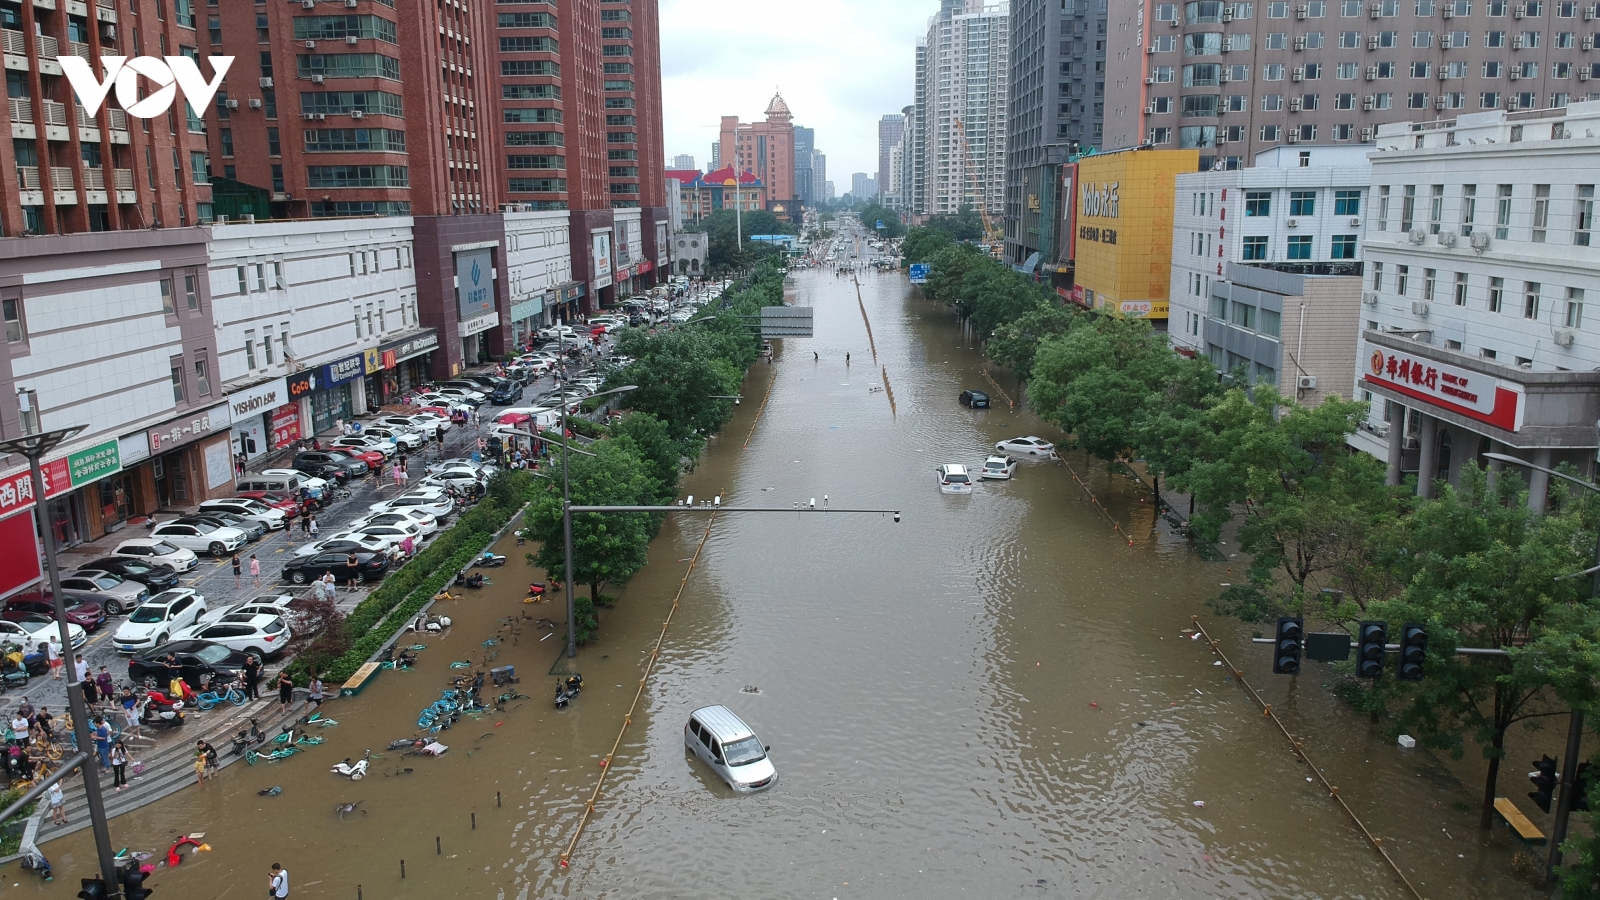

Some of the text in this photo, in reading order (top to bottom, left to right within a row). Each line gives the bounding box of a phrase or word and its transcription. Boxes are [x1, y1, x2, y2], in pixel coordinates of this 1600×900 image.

[1063, 177, 1072, 220] 7
[1082, 182, 1100, 217] Yolo
[1101, 181, 1119, 218] 永乐
[1386, 355, 1438, 390] 郑州银行
